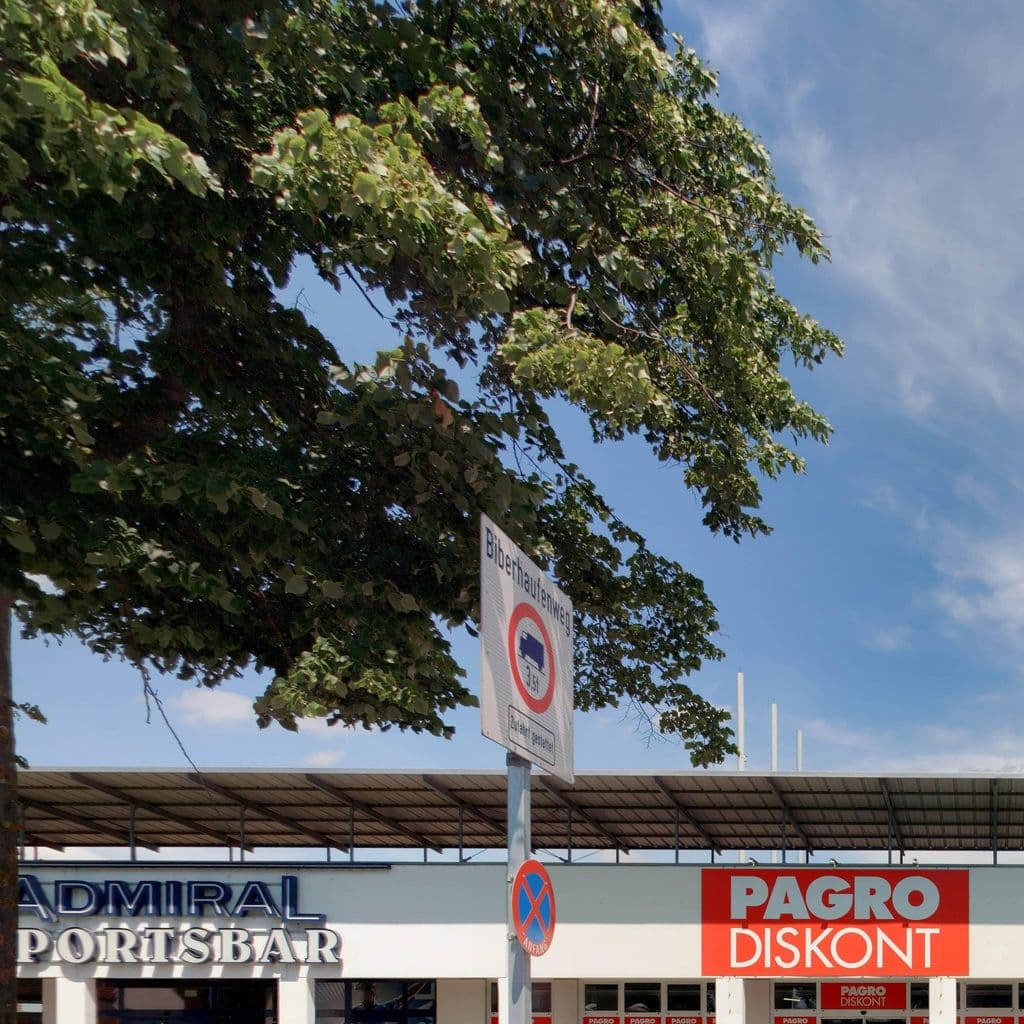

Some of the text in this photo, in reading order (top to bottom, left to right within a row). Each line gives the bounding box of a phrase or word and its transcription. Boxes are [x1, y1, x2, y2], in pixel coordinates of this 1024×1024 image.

[484, 526, 571, 637] Biberhaufenweg
[17, 875, 327, 923] ADMIRAL
[730, 875, 941, 920] PAGRO
[17, 927, 342, 964] PORTSBAR
[730, 926, 941, 969] DISKONT
[840, 985, 887, 996] PAGRO
[840, 996, 887, 1007] DISKONT
